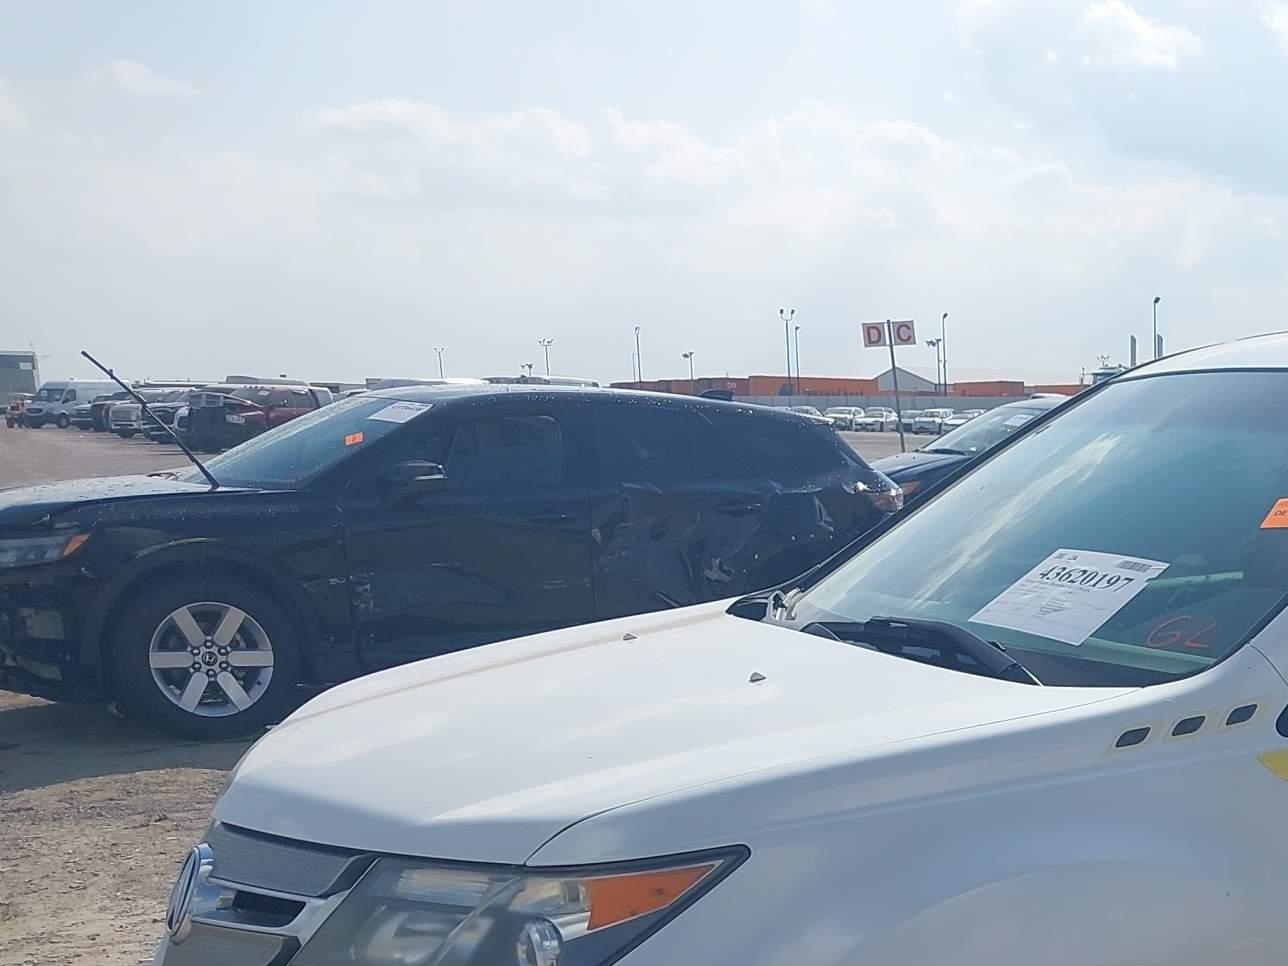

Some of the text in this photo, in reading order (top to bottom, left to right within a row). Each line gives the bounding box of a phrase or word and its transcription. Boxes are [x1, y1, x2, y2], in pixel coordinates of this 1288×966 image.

[866, 323, 912, 344] D C
[1039, 566, 1134, 592] 43620197
